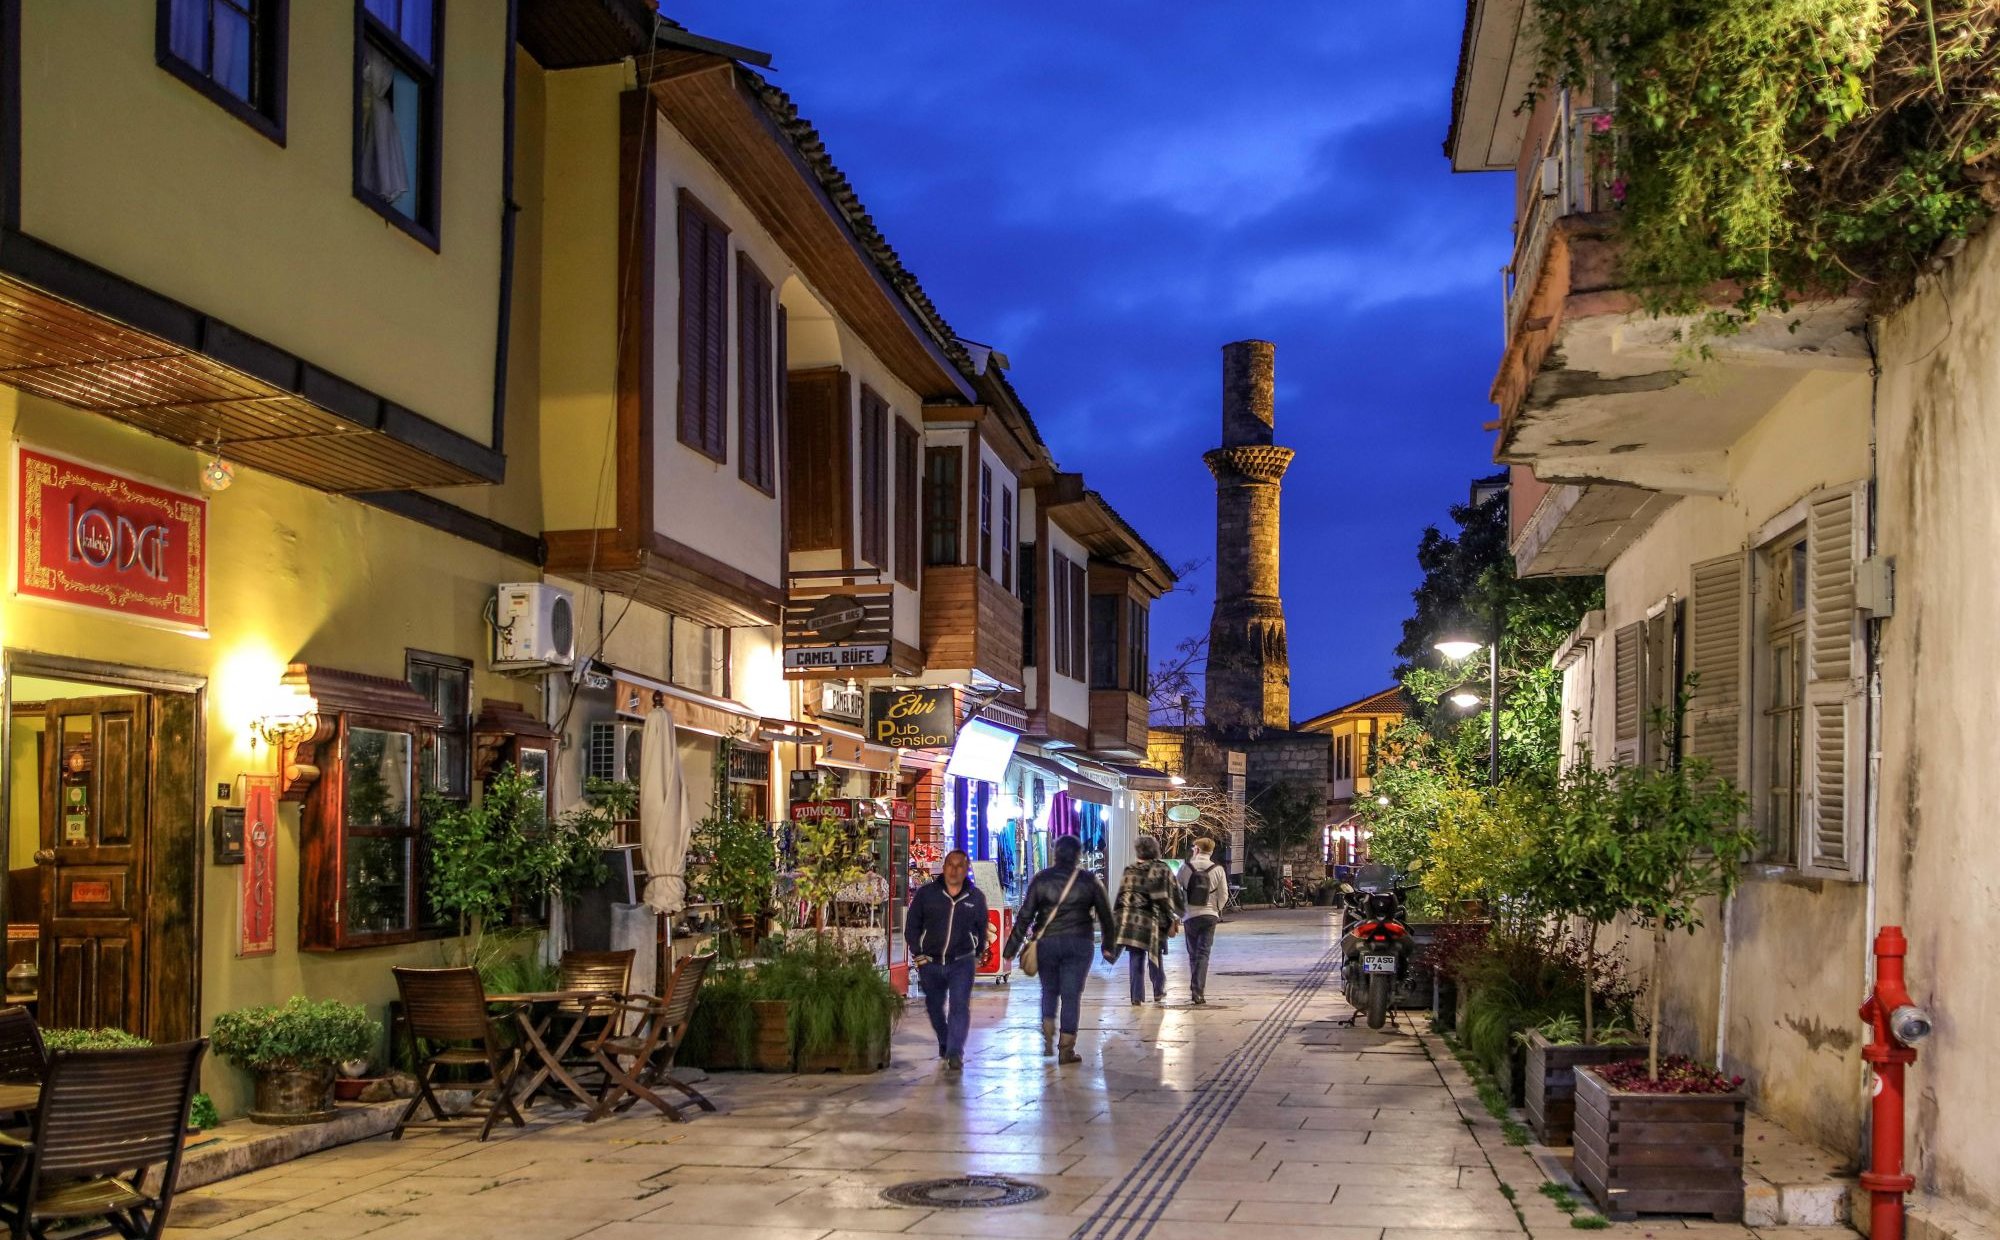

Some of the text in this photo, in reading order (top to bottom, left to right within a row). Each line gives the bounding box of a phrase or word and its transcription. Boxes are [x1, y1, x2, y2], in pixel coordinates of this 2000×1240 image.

[68, 503, 169, 582] LODGE
[796, 647, 874, 665] CAMEL BÜFE
[888, 694, 937, 719] Elvi
